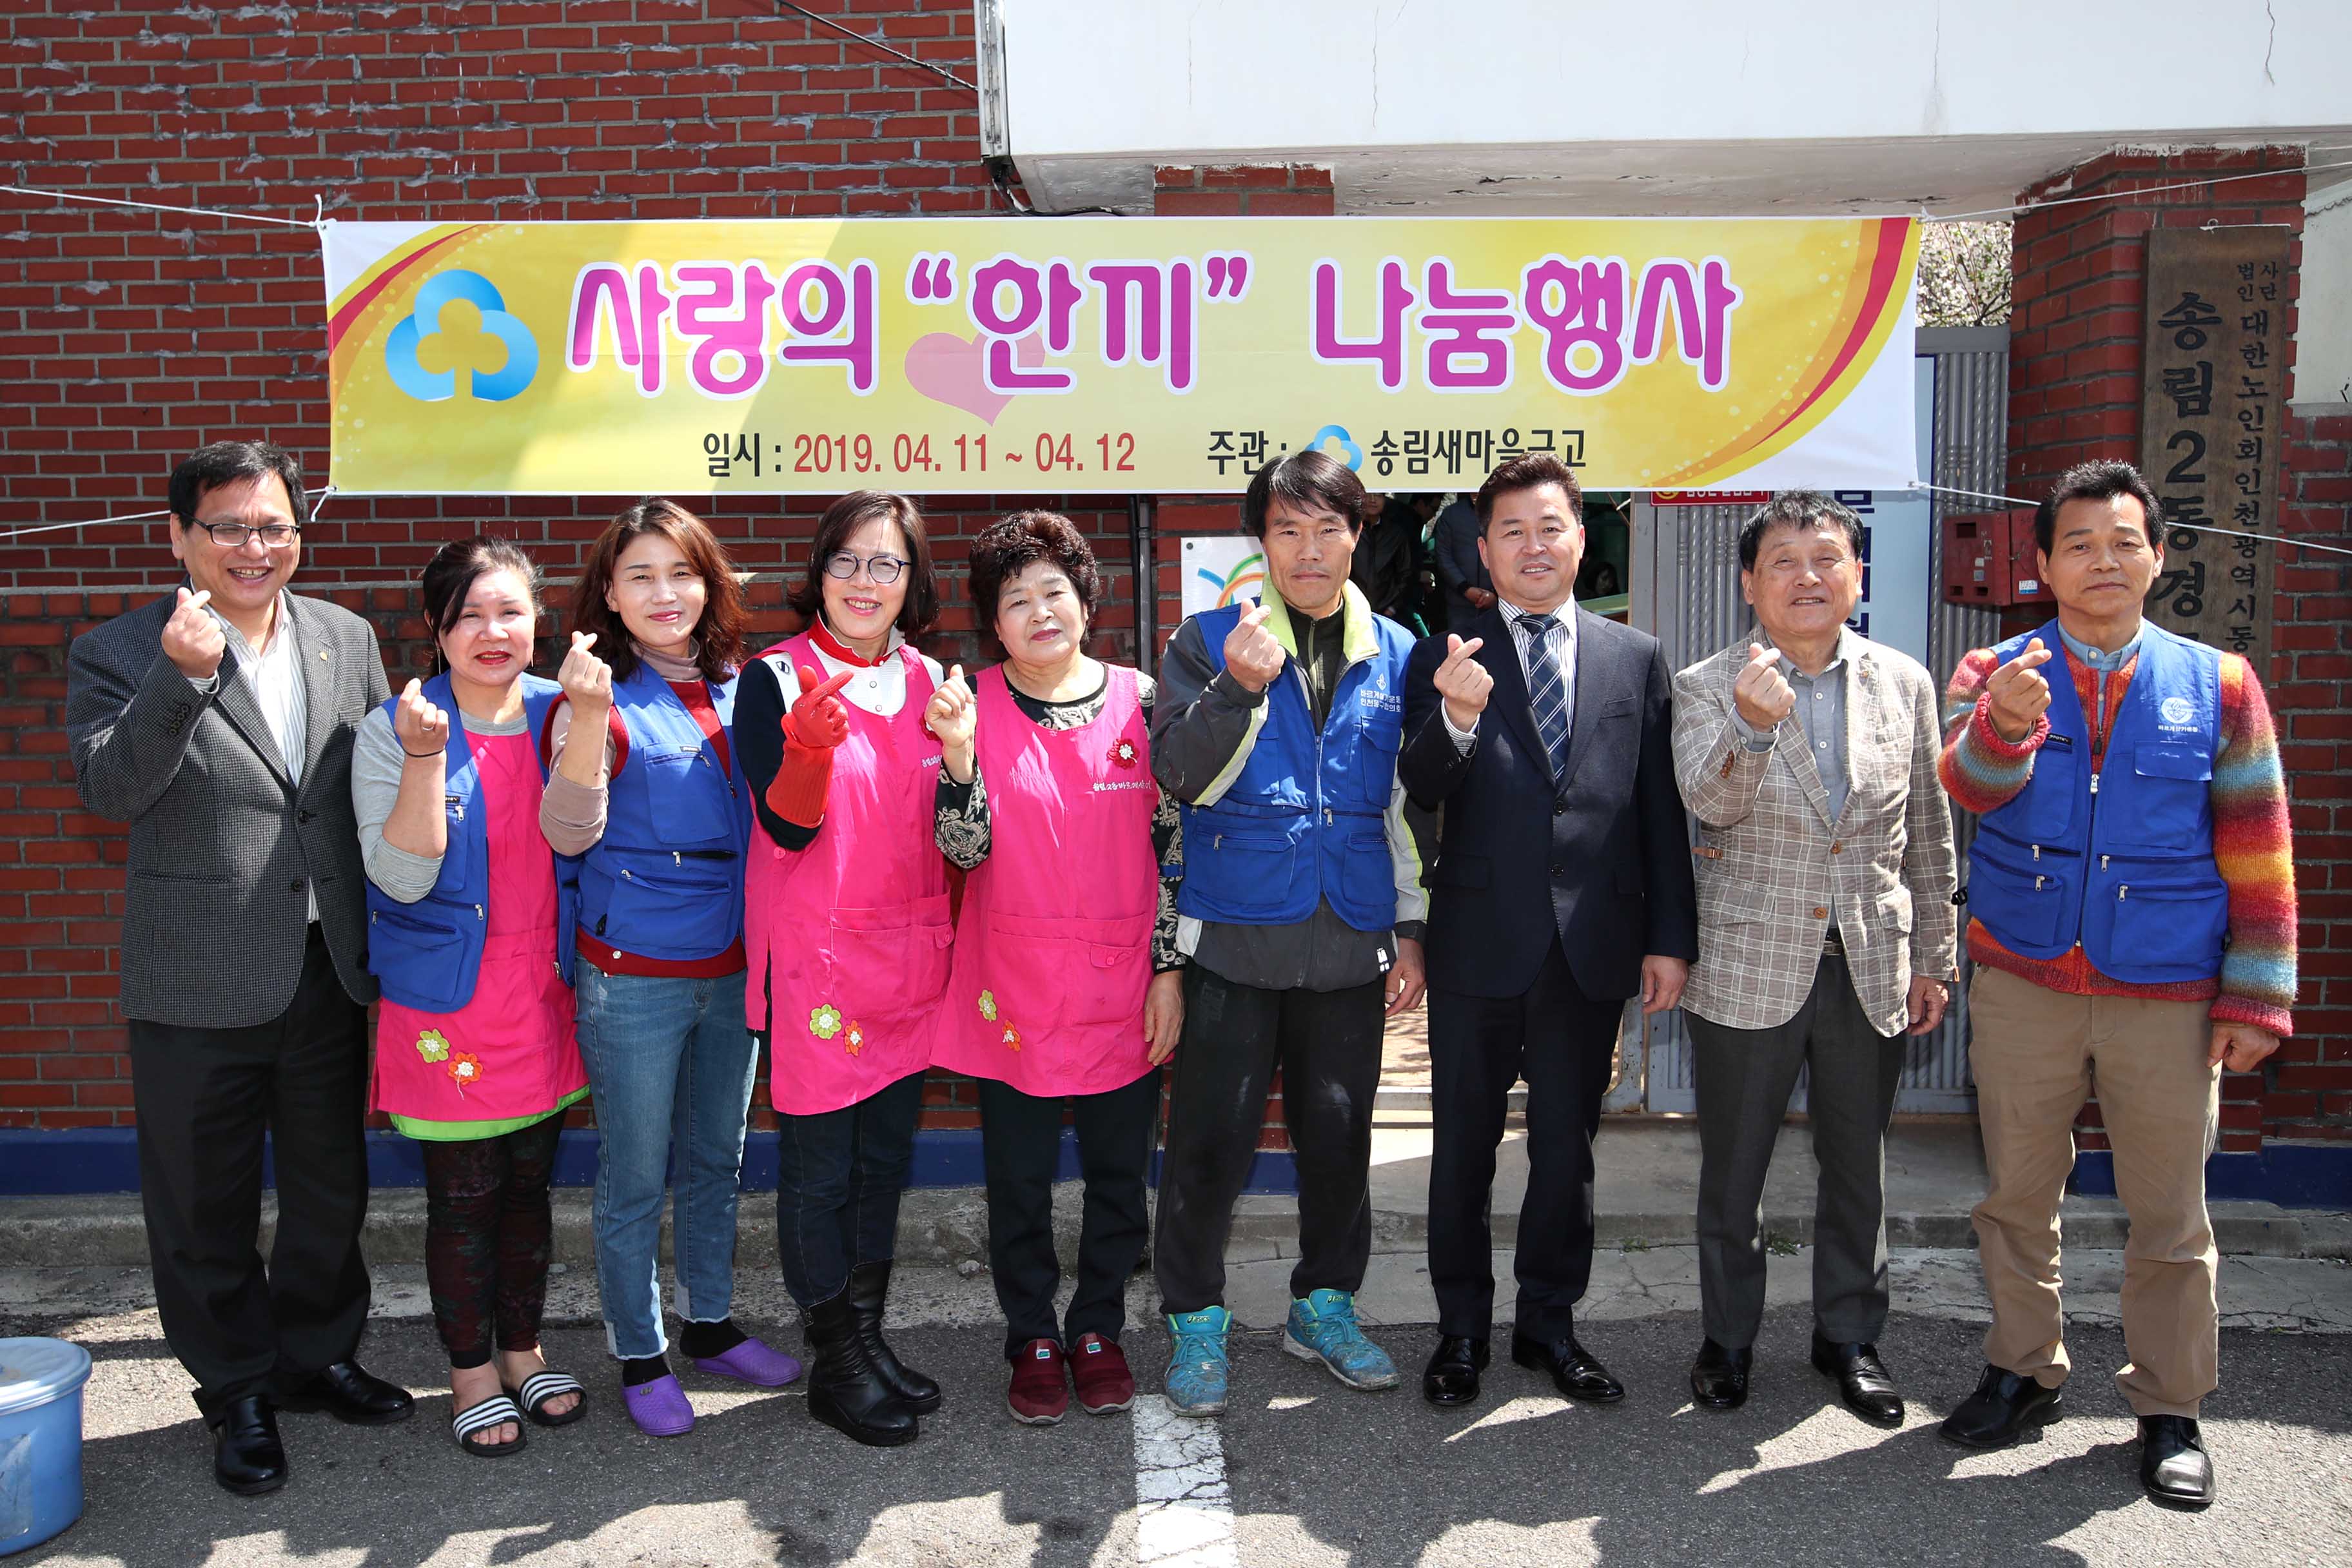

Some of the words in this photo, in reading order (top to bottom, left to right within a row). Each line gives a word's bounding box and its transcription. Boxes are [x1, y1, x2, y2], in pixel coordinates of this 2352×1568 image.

[567, 259, 877, 399] 사랑의
[1312, 253, 1740, 395] 나눔행사
[703, 433, 760, 476] 일시
[794, 434, 881, 473] 2019.
[894, 434, 941, 473] 04.
[954, 434, 986, 471] 11
[1035, 433, 1083, 471] 04.
[1097, 433, 1135, 471] 12
[1207, 431, 1269, 475] 주관
[2153, 291, 2222, 641] 송림2동경
